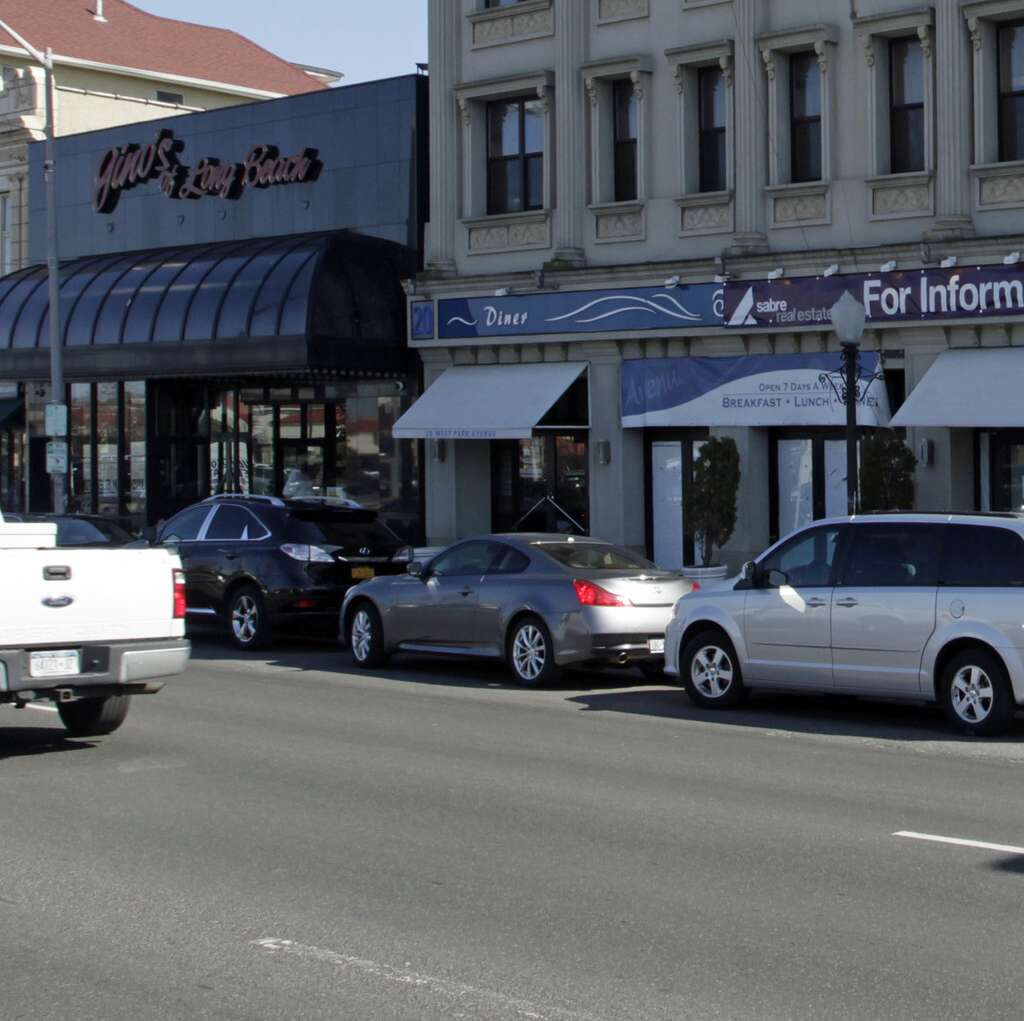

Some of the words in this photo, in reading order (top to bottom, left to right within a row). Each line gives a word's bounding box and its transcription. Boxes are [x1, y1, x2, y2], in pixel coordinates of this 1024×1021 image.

[179, 156, 237, 199] Long
[241, 143, 313, 189] Beach
[756, 298, 787, 313] sabre
[864, 280, 912, 317] For
[412, 305, 434, 335] 20
[483, 305, 529, 328] Diner
[759, 383, 781, 392] OPEN
[783, 382, 789, 392] 7
[790, 382, 811, 392] DAYS
[813, 381, 819, 391] A
[722, 398, 782, 409] BREAKFAST
[794, 396, 830, 408] LUNCH
[454, 429, 469, 438] PARK
